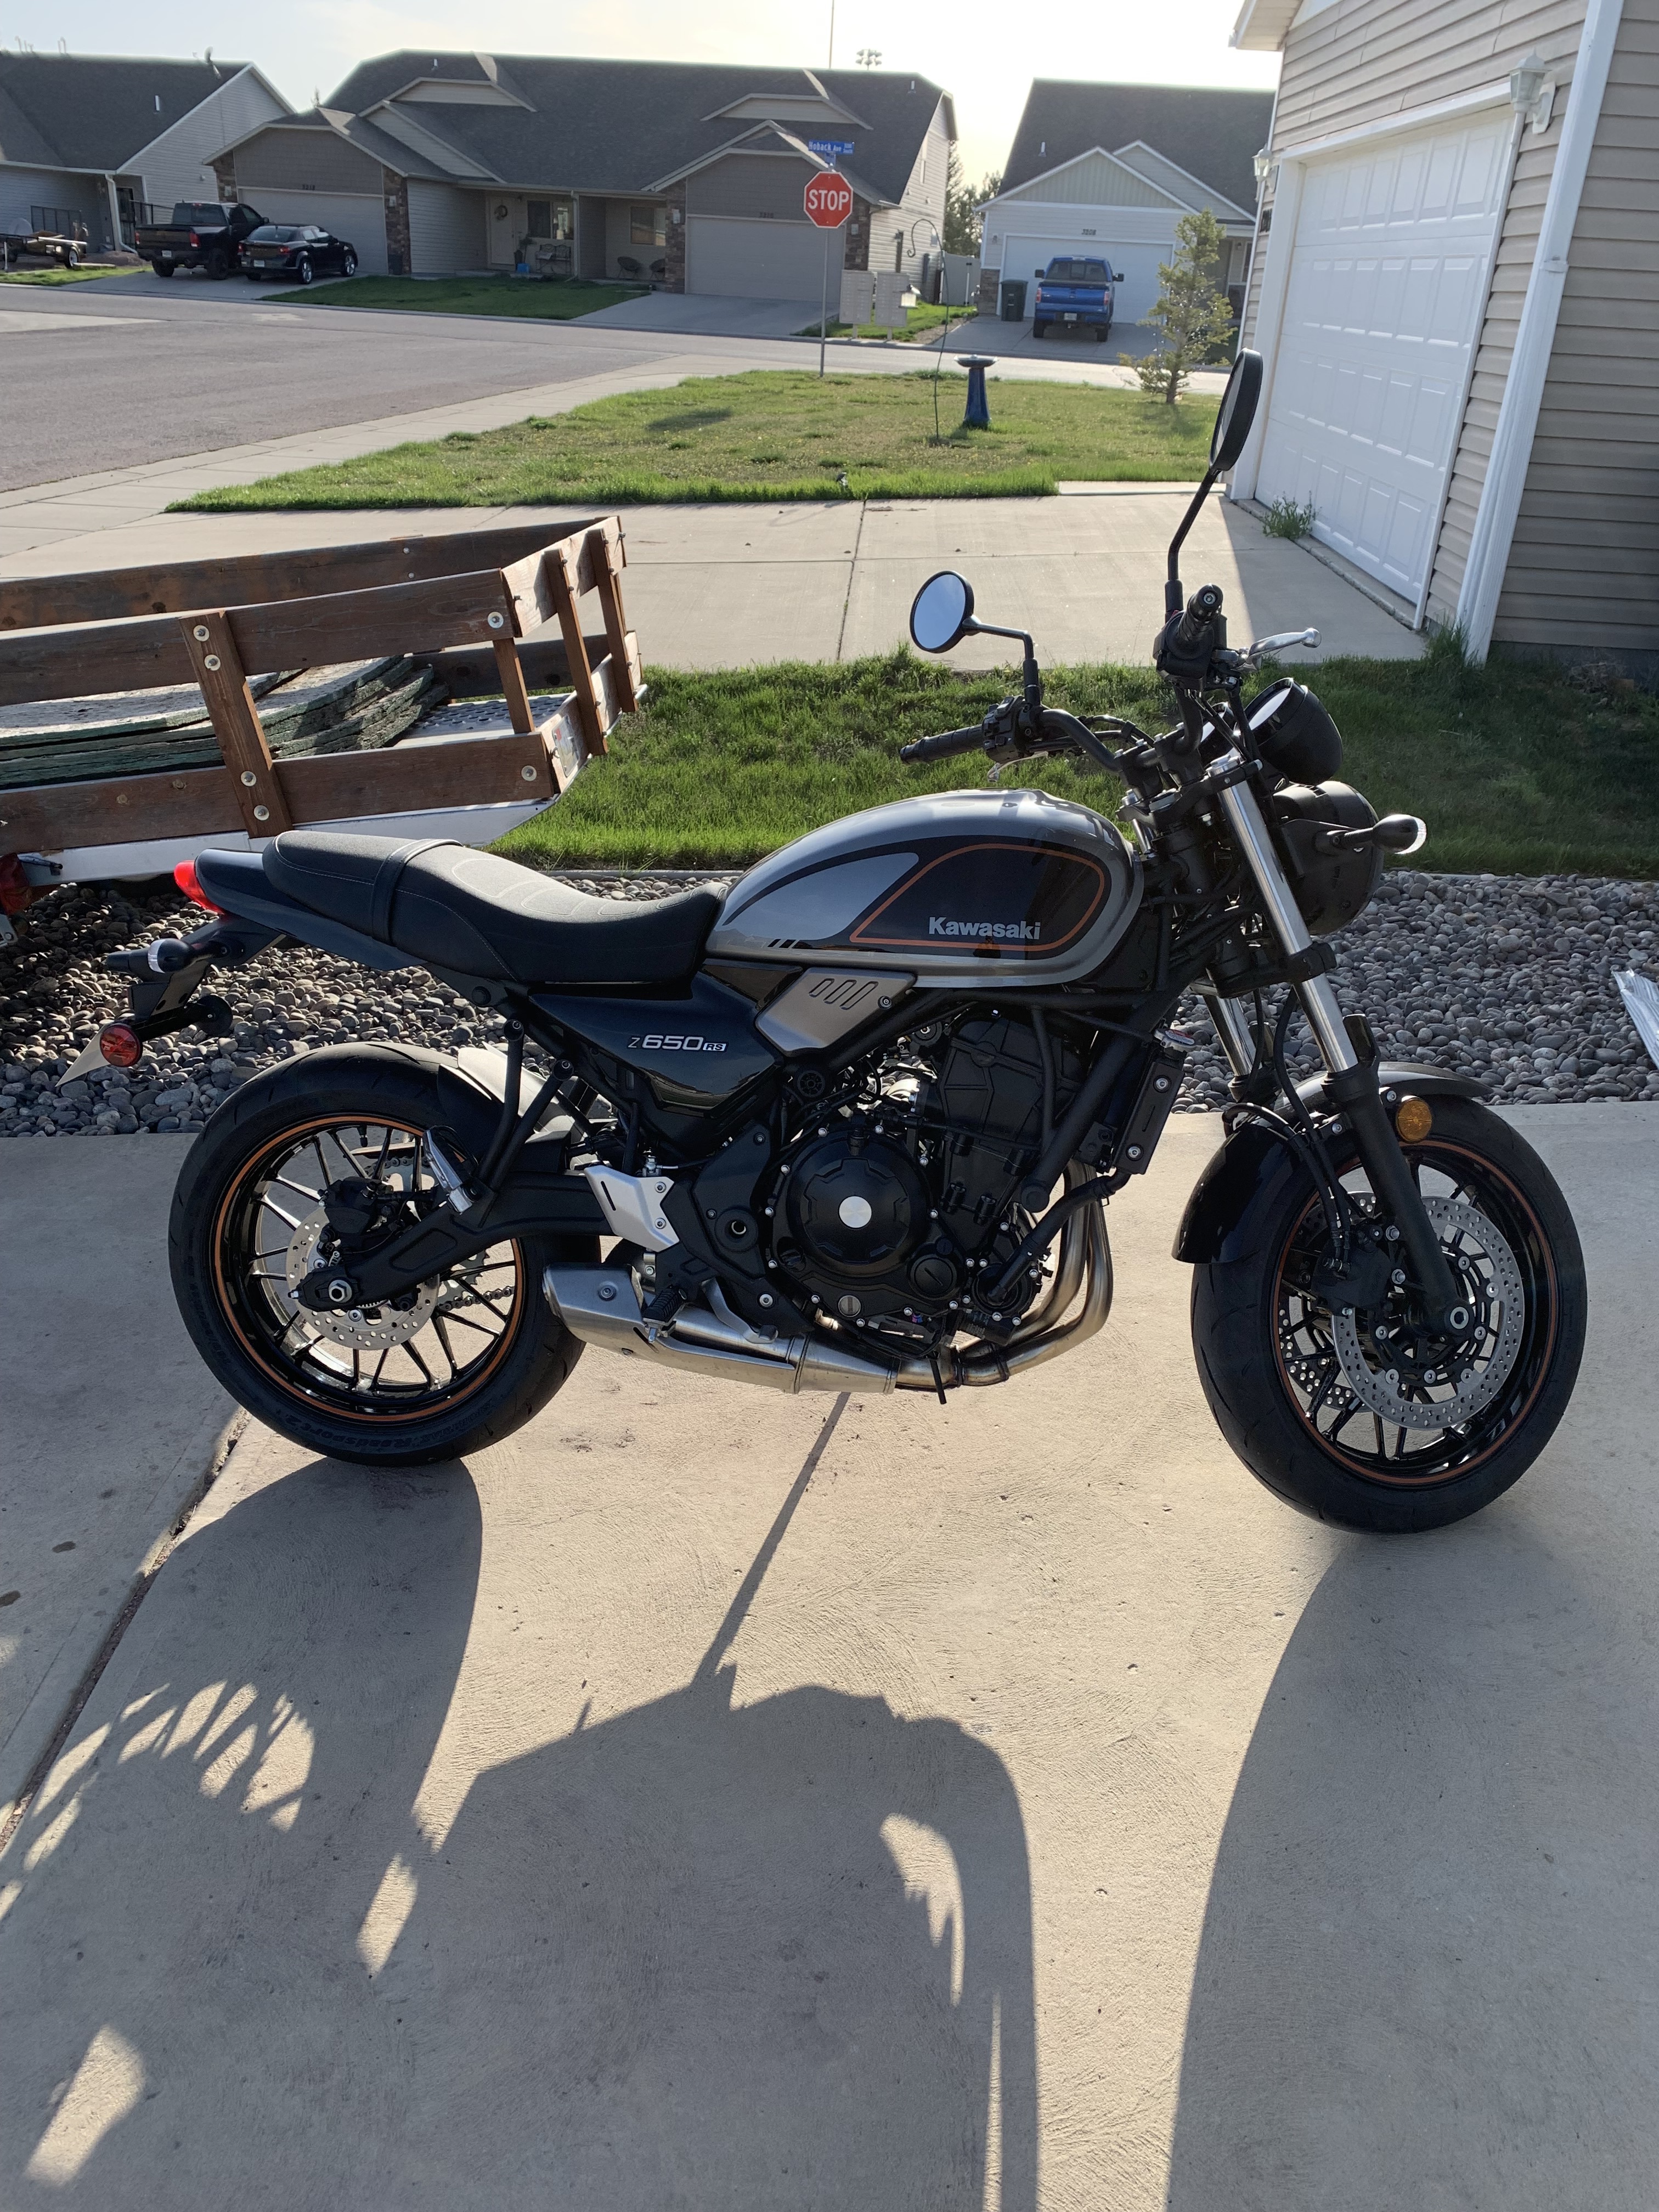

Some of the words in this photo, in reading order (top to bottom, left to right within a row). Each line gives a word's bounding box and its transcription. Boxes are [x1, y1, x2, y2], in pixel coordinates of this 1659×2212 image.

[809, 142, 831, 151] Hoback
[808, 189, 849, 211] STOP
[929, 917, 1041, 940] Kawasaki
